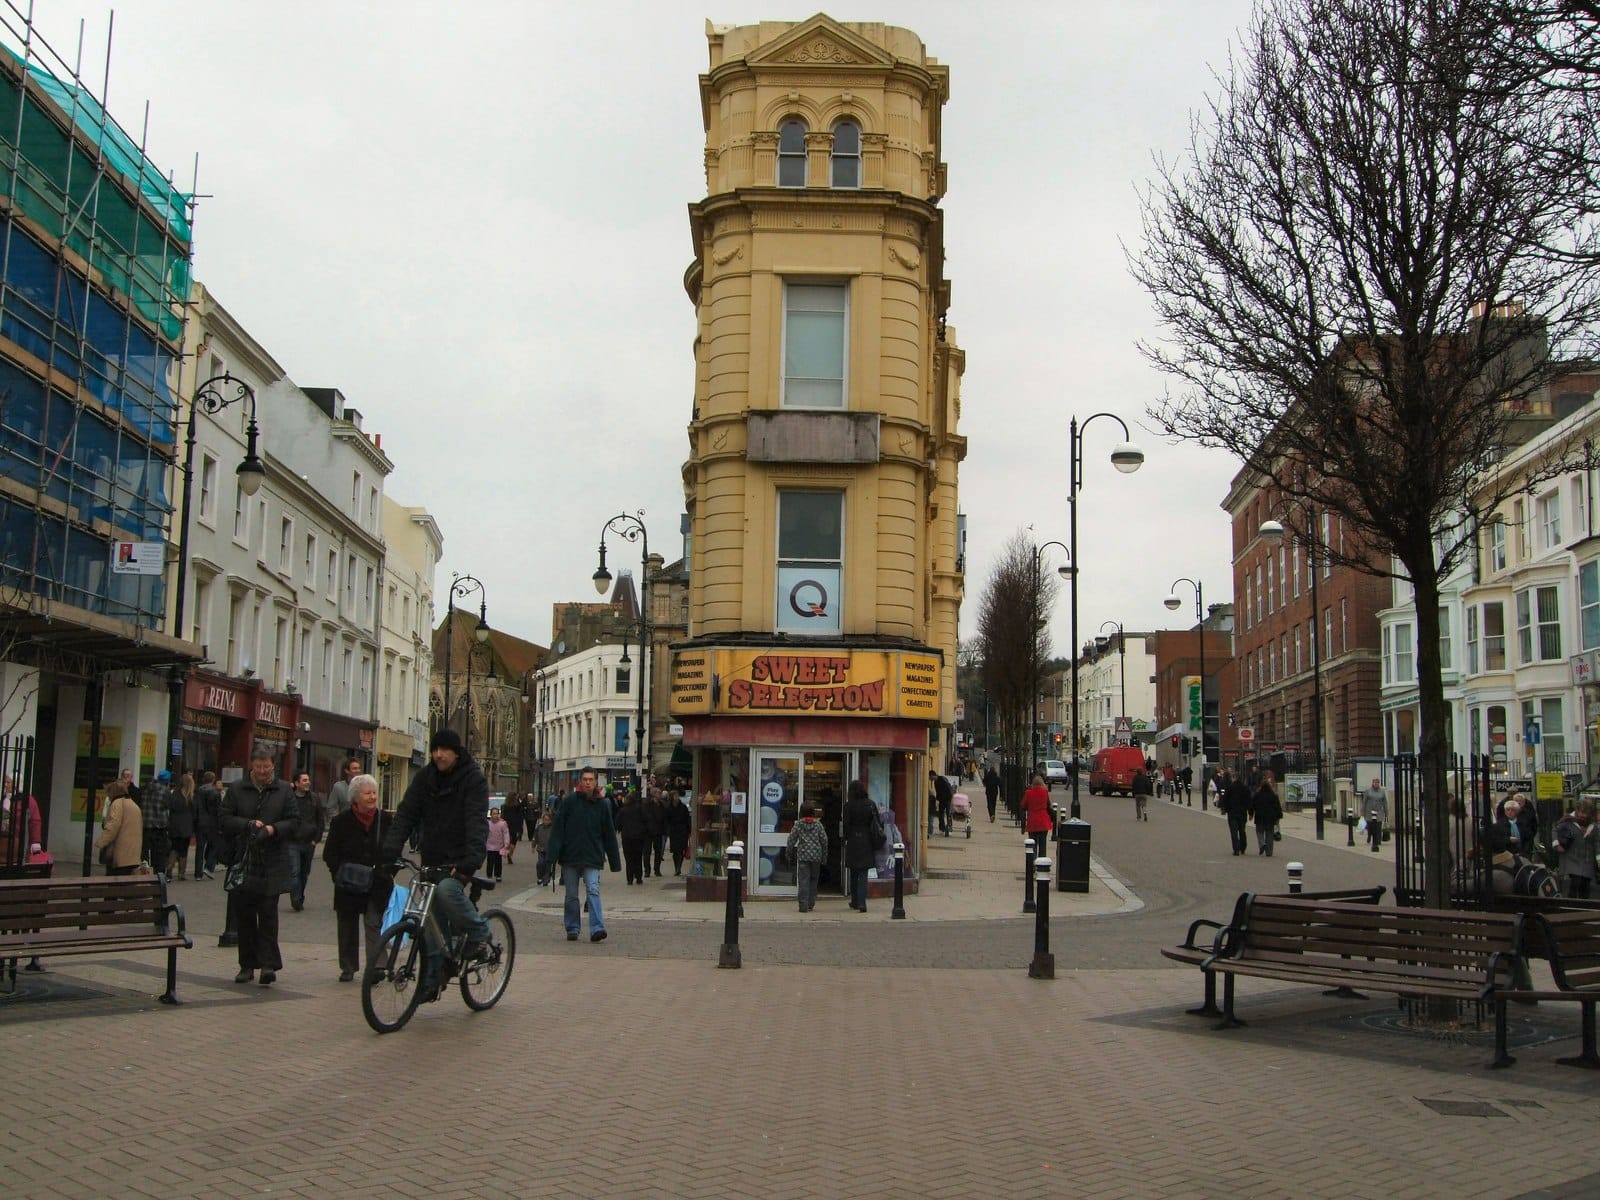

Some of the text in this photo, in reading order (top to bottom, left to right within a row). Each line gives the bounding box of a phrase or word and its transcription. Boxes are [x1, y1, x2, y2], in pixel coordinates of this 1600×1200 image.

[789, 580, 828, 617] Q
[752, 655, 850, 685] SWEET
[904, 662, 936, 672] NEWSPAPERS
[677, 671, 704, 679] MAGAZINES
[906, 674, 934, 684] MAGAZINES
[728, 678, 885, 711] SELECTION
[901, 686, 938, 697] CONFECTIONERY
[208, 687, 236, 713] REINA
[677, 695, 703, 704] CIGARETTES
[906, 699, 933, 708] CIGARETTES
[259, 701, 281, 724] REINA
